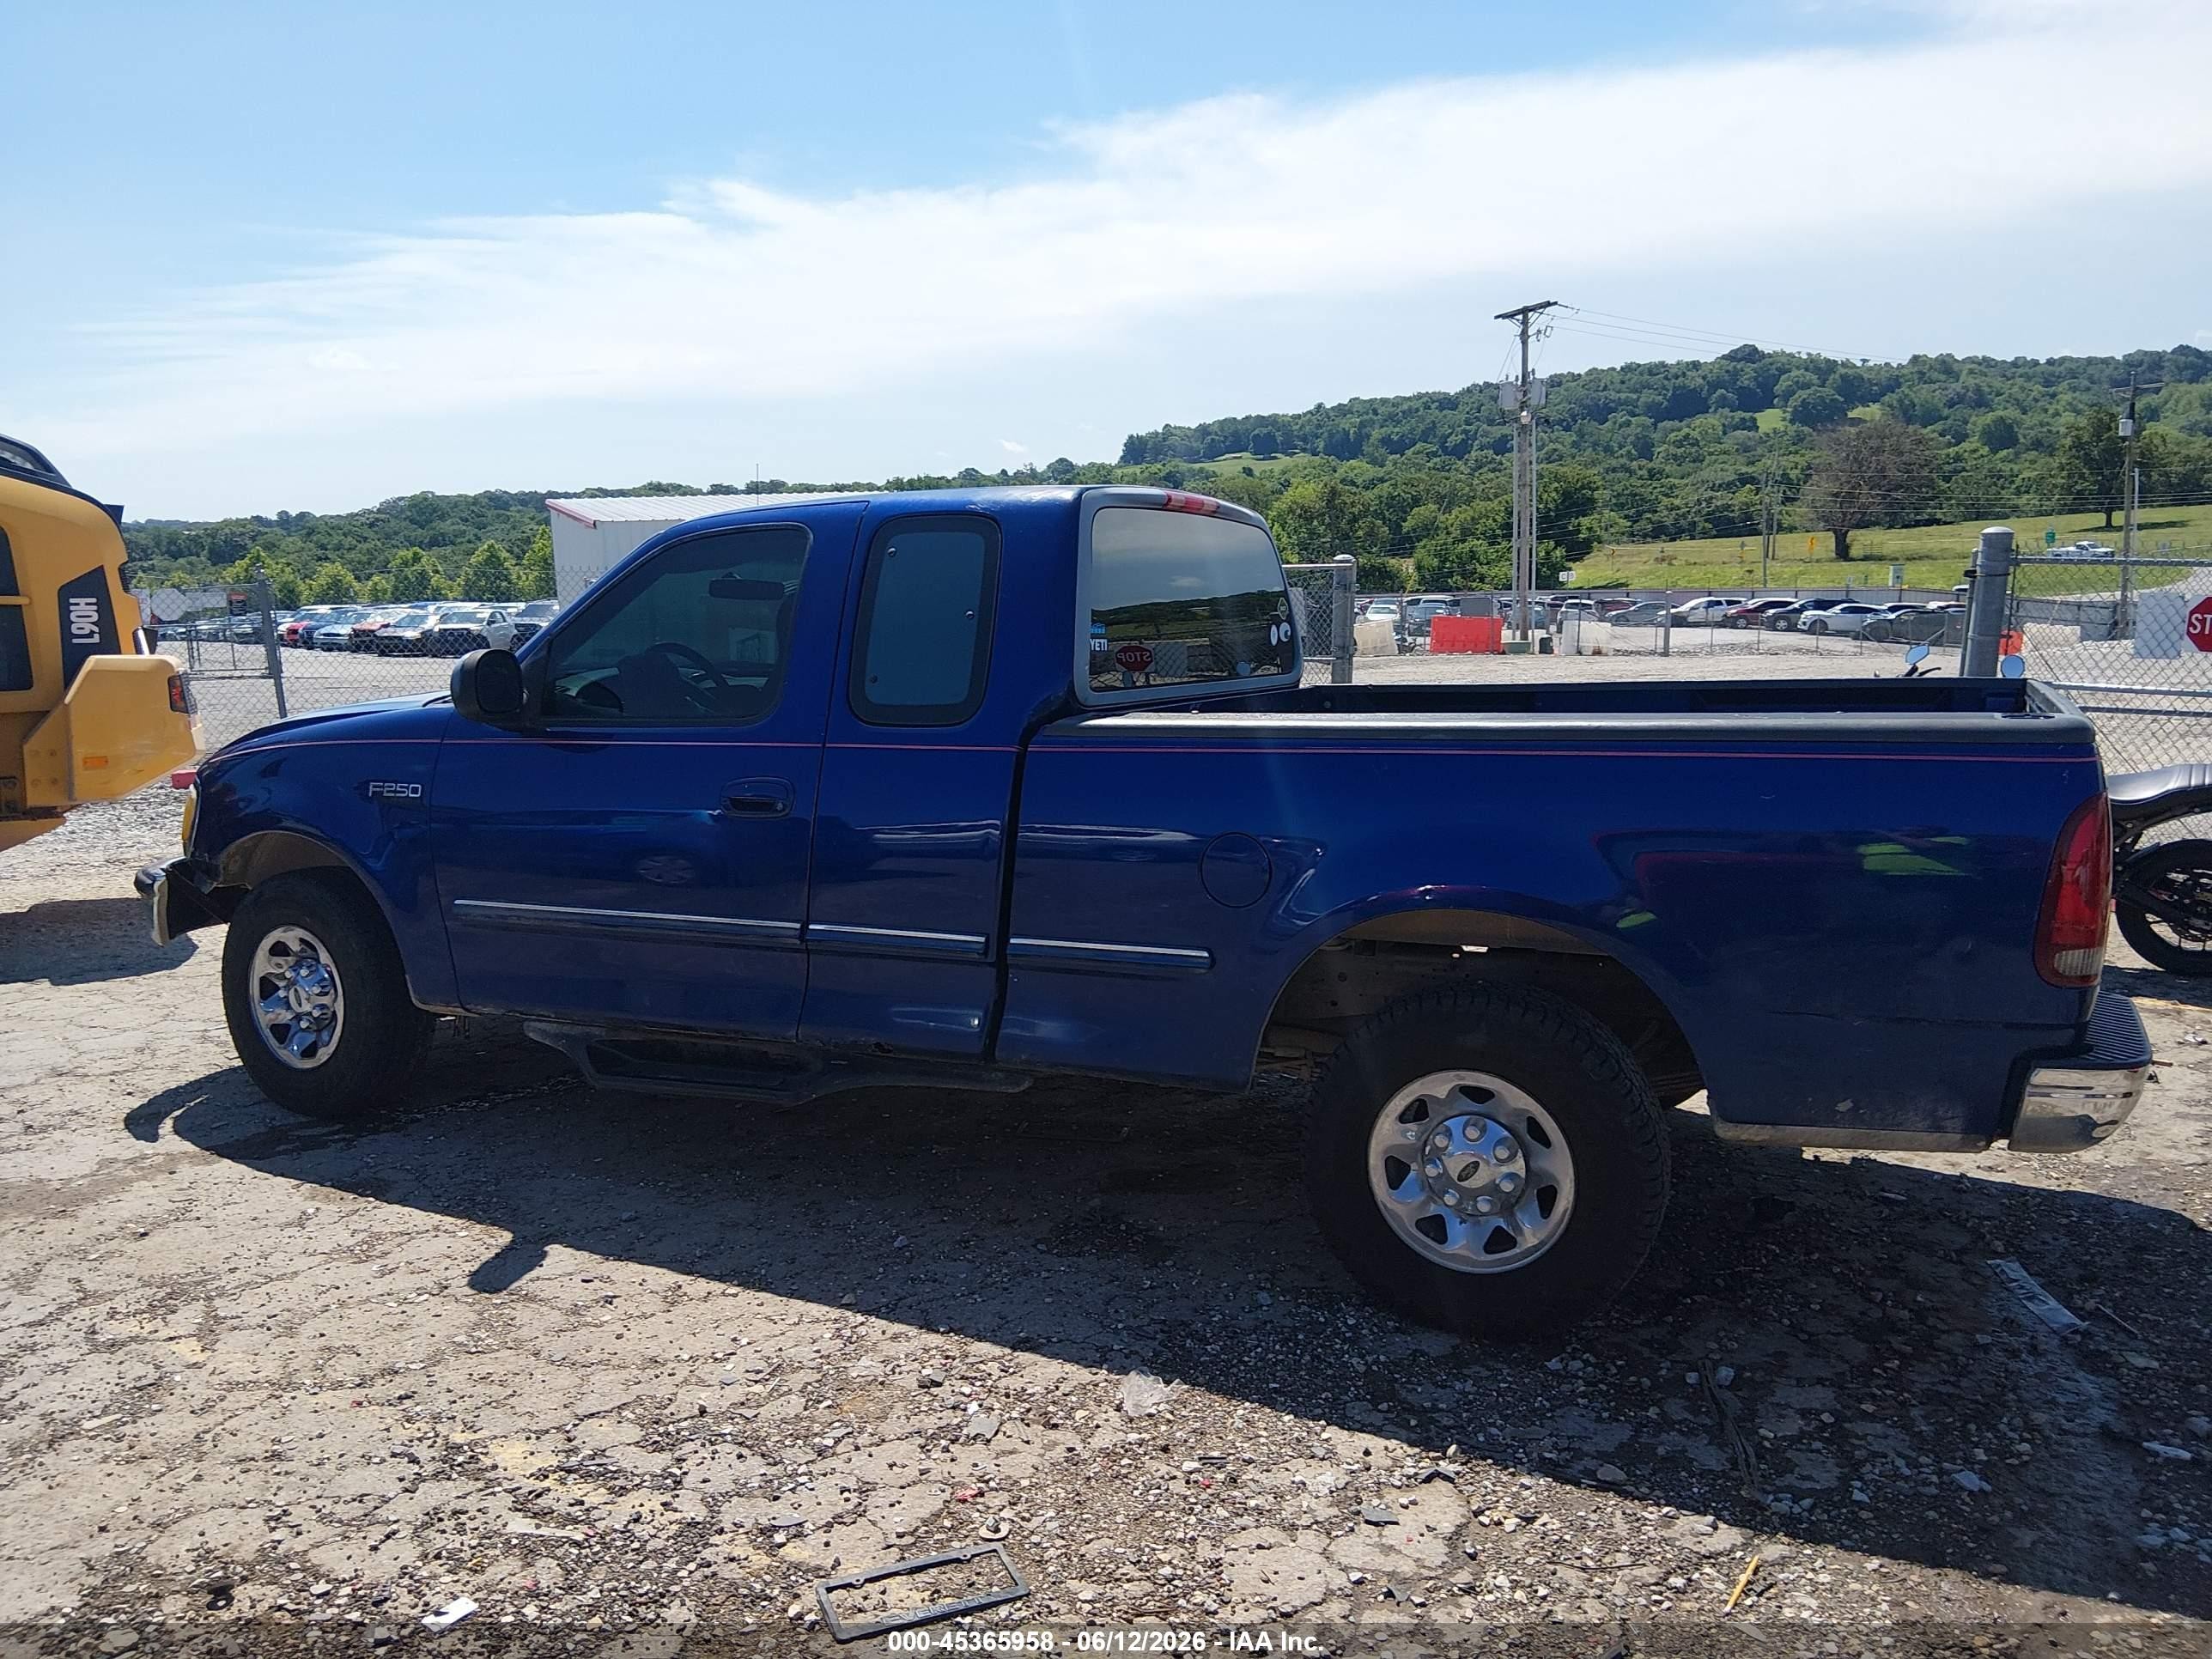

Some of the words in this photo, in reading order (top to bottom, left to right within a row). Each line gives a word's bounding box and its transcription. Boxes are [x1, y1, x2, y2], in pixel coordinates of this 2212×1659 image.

[69, 598, 100, 643] L90H
[2189, 613, 2212, 634] ST
[1090, 639, 1108, 651] YETI
[368, 782, 422, 797] F250
[879, 1596, 986, 1625] EVERETT
